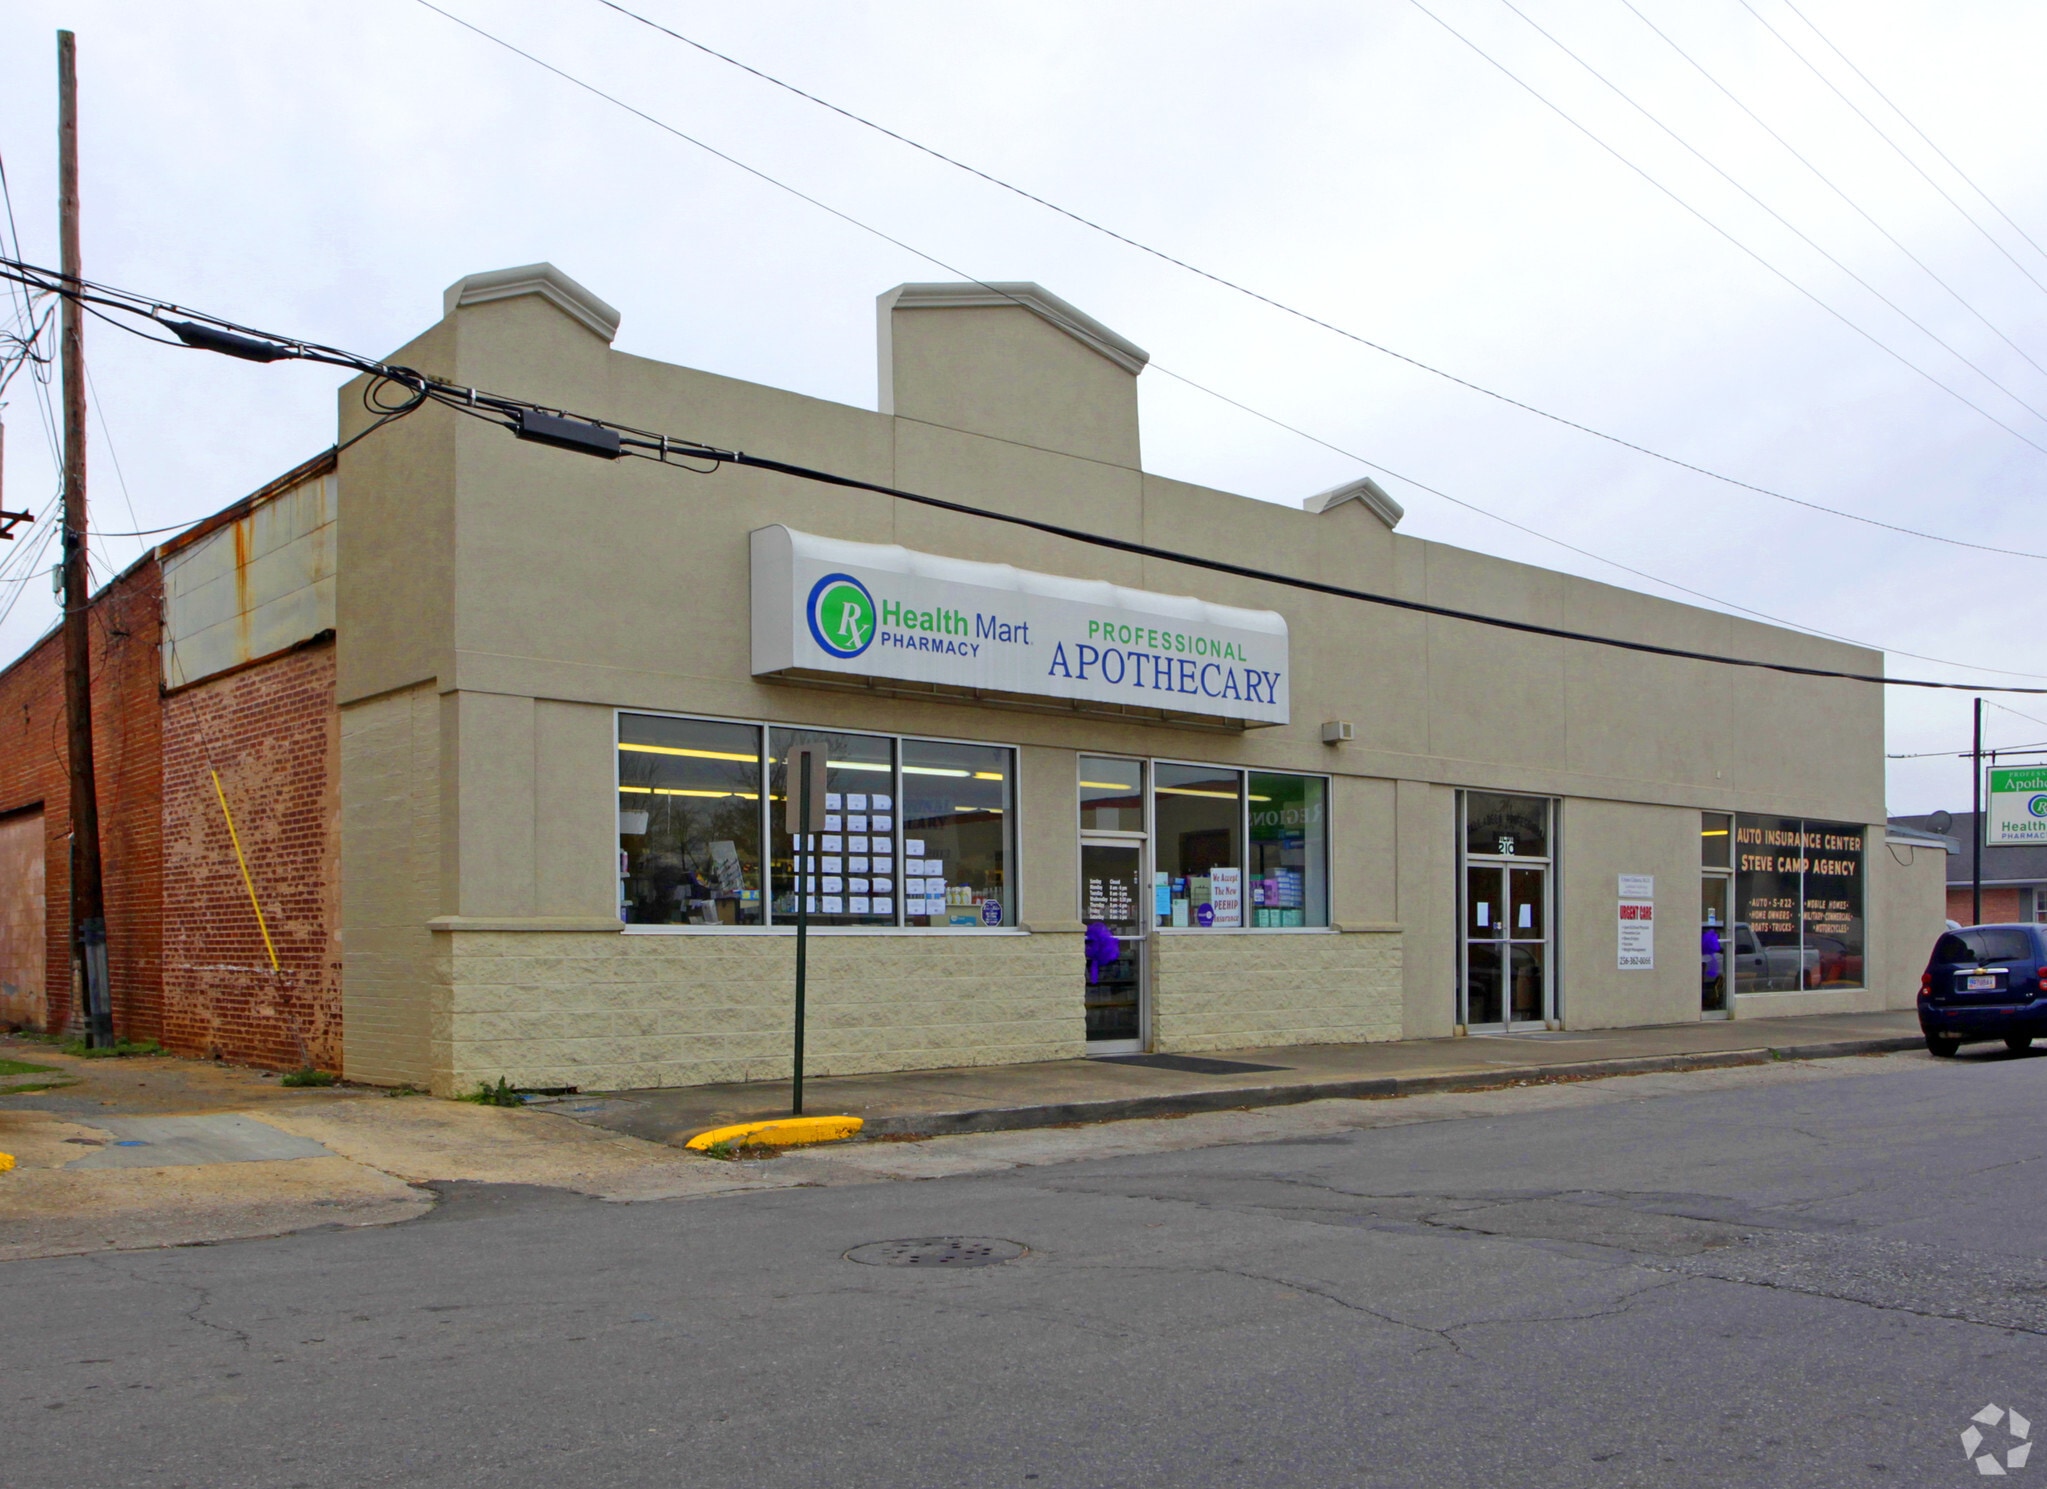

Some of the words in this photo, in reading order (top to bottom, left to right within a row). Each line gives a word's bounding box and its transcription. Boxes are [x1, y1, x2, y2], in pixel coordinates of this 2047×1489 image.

[882, 599, 969, 636] Health
[976, 613, 1030, 645] Mart
[881, 631, 980, 657] PHARMACY
[1088, 620, 1247, 662] PROFESSIONAL
[1048, 640, 1281, 704] APOTHECARY
[2002, 821, 2047, 831] Health
[1498, 843, 1515, 854] 210
[1737, 828, 1762, 844] AUTO
[1765, 830, 1821, 848] INSURANCE
[1825, 834, 1861, 851] CENTER
[1741, 854, 1773, 872] STEVE
[1778, 857, 1809, 873] CAMP
[1813, 859, 1855, 876] AGENCY
[1221, 873, 1238, 883] Accept
[1215, 886, 1224, 895] The
[1225, 886, 1237, 895] New
[1752, 898, 1767, 907] AUTO
[1620, 905, 1639, 920] URGENT
[1640, 905, 1652, 920] CARE
